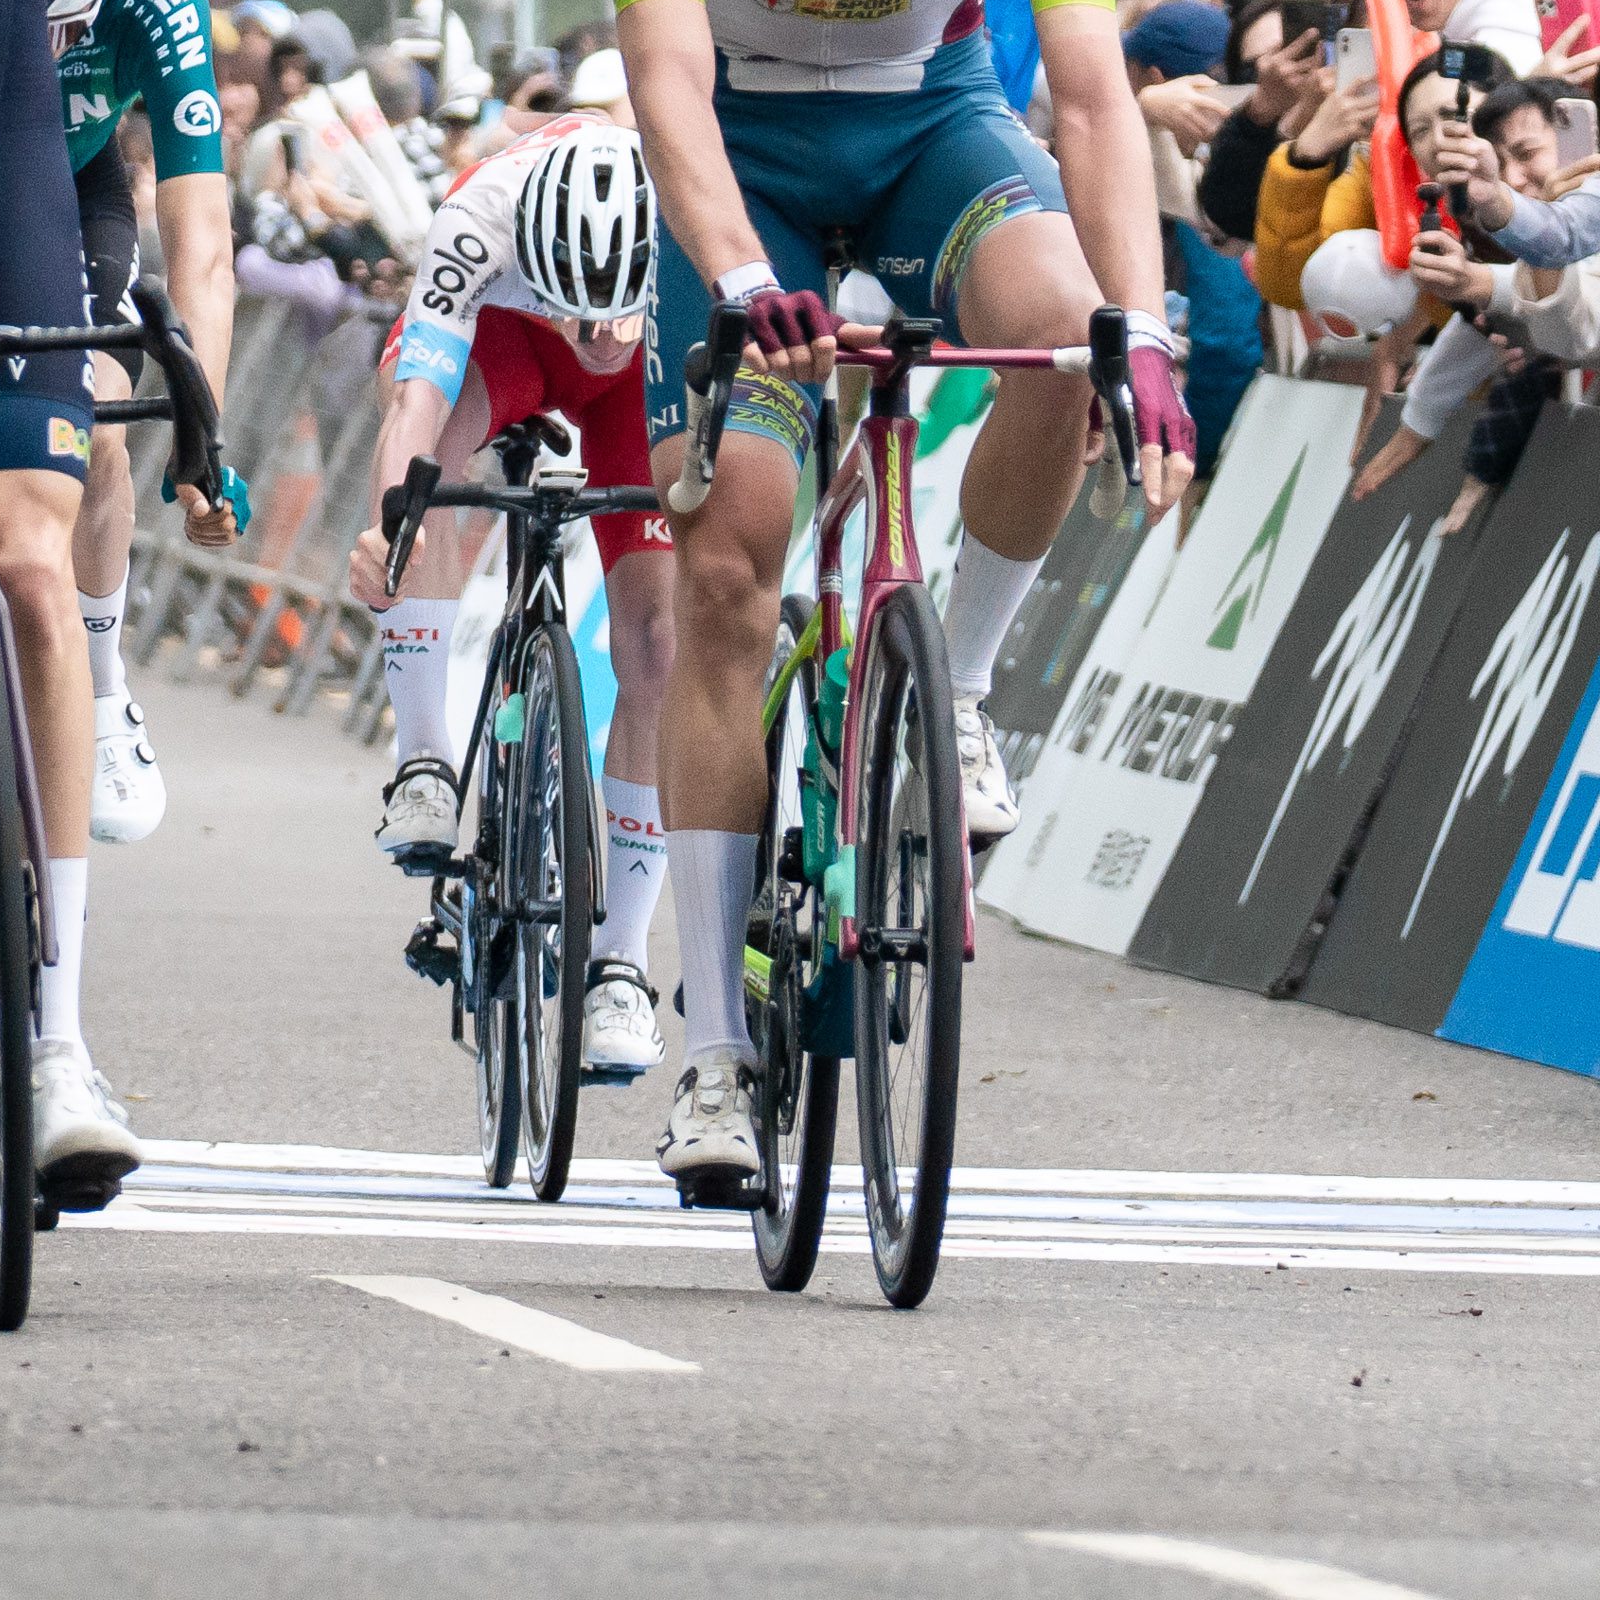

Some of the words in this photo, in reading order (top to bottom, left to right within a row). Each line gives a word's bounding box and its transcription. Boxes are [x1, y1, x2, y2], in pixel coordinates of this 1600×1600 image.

[422, 232, 489, 316] solo
[878, 256, 925, 275] URSUS
[886, 431, 903, 567] corratec
